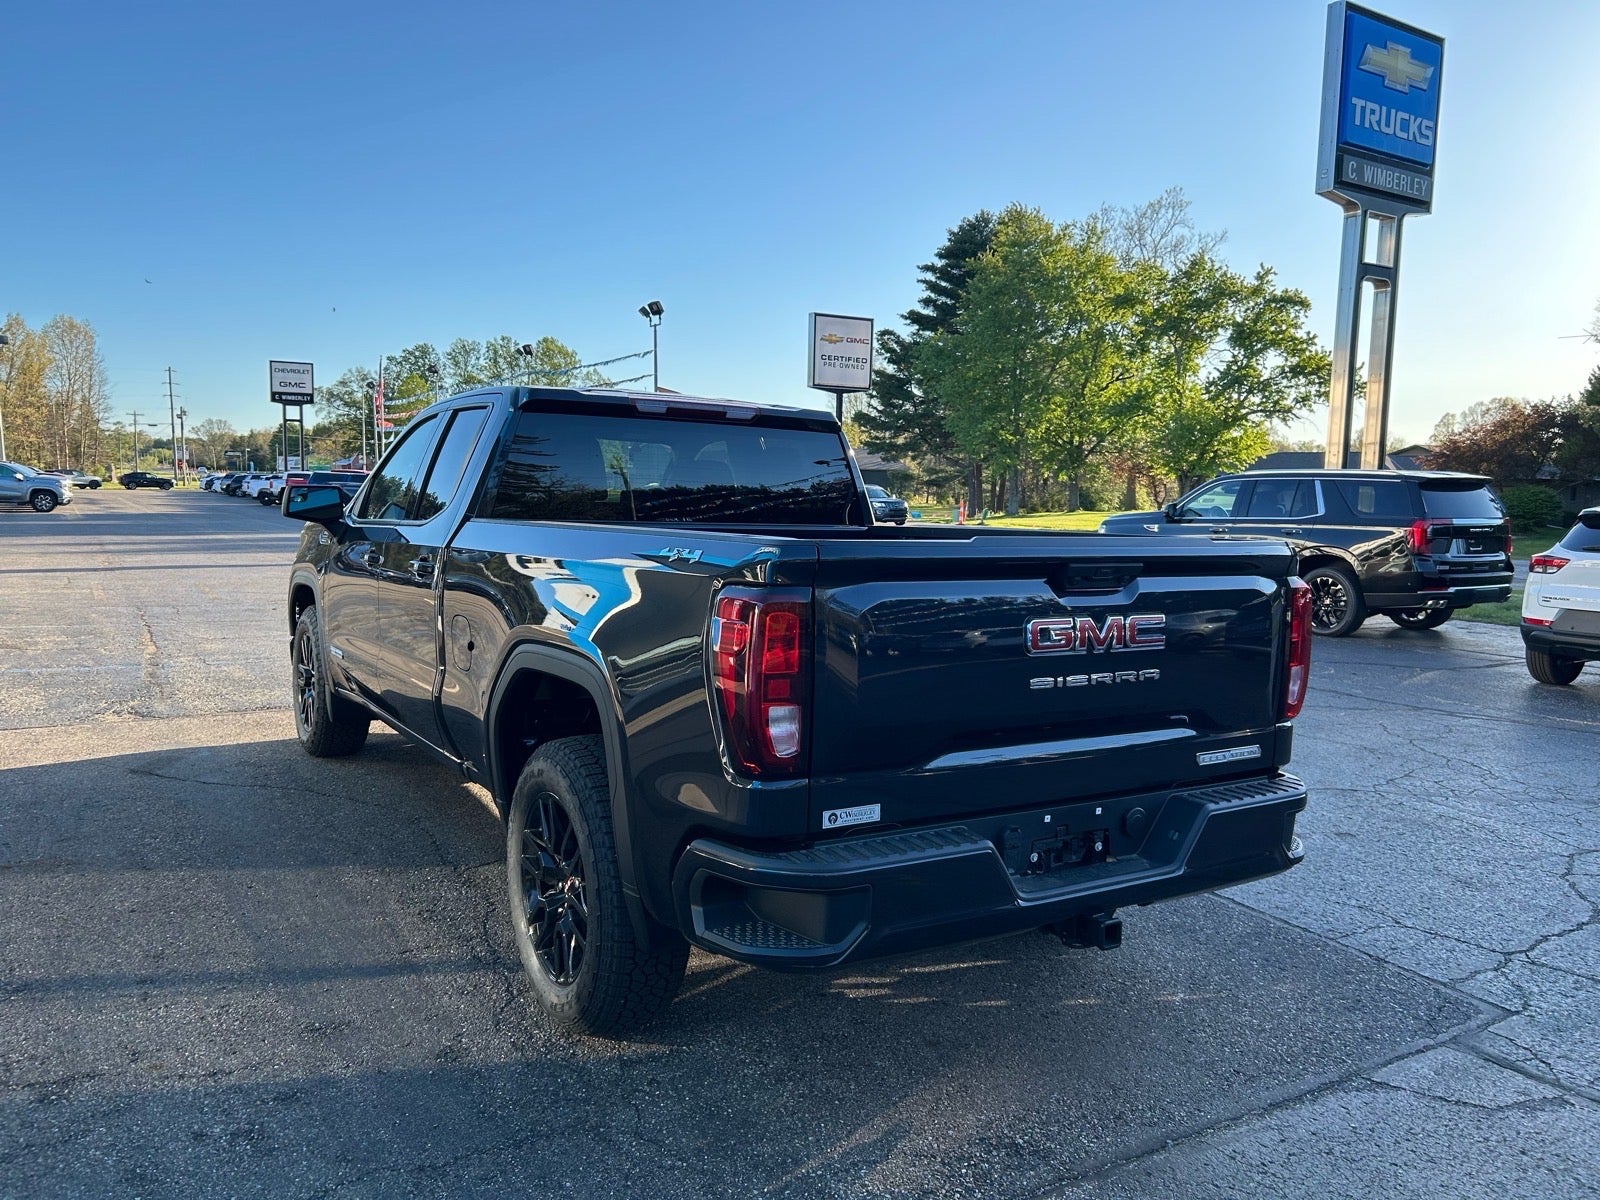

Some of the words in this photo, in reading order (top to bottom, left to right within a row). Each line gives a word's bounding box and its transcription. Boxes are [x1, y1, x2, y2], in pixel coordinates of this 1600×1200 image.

[1351, 97, 1434, 146] TRUCKS
[1348, 160, 1358, 181] C.
[1363, 163, 1428, 197] WIMBERLEY
[846, 336, 870, 345] GMC
[820, 354, 868, 364] CERTIFIED
[273, 367, 310, 375] CHEVROLET
[279, 381, 307, 389] GMC
[1025, 614, 1166, 657] GMC
[1029, 668, 1161, 690] SIERRA
